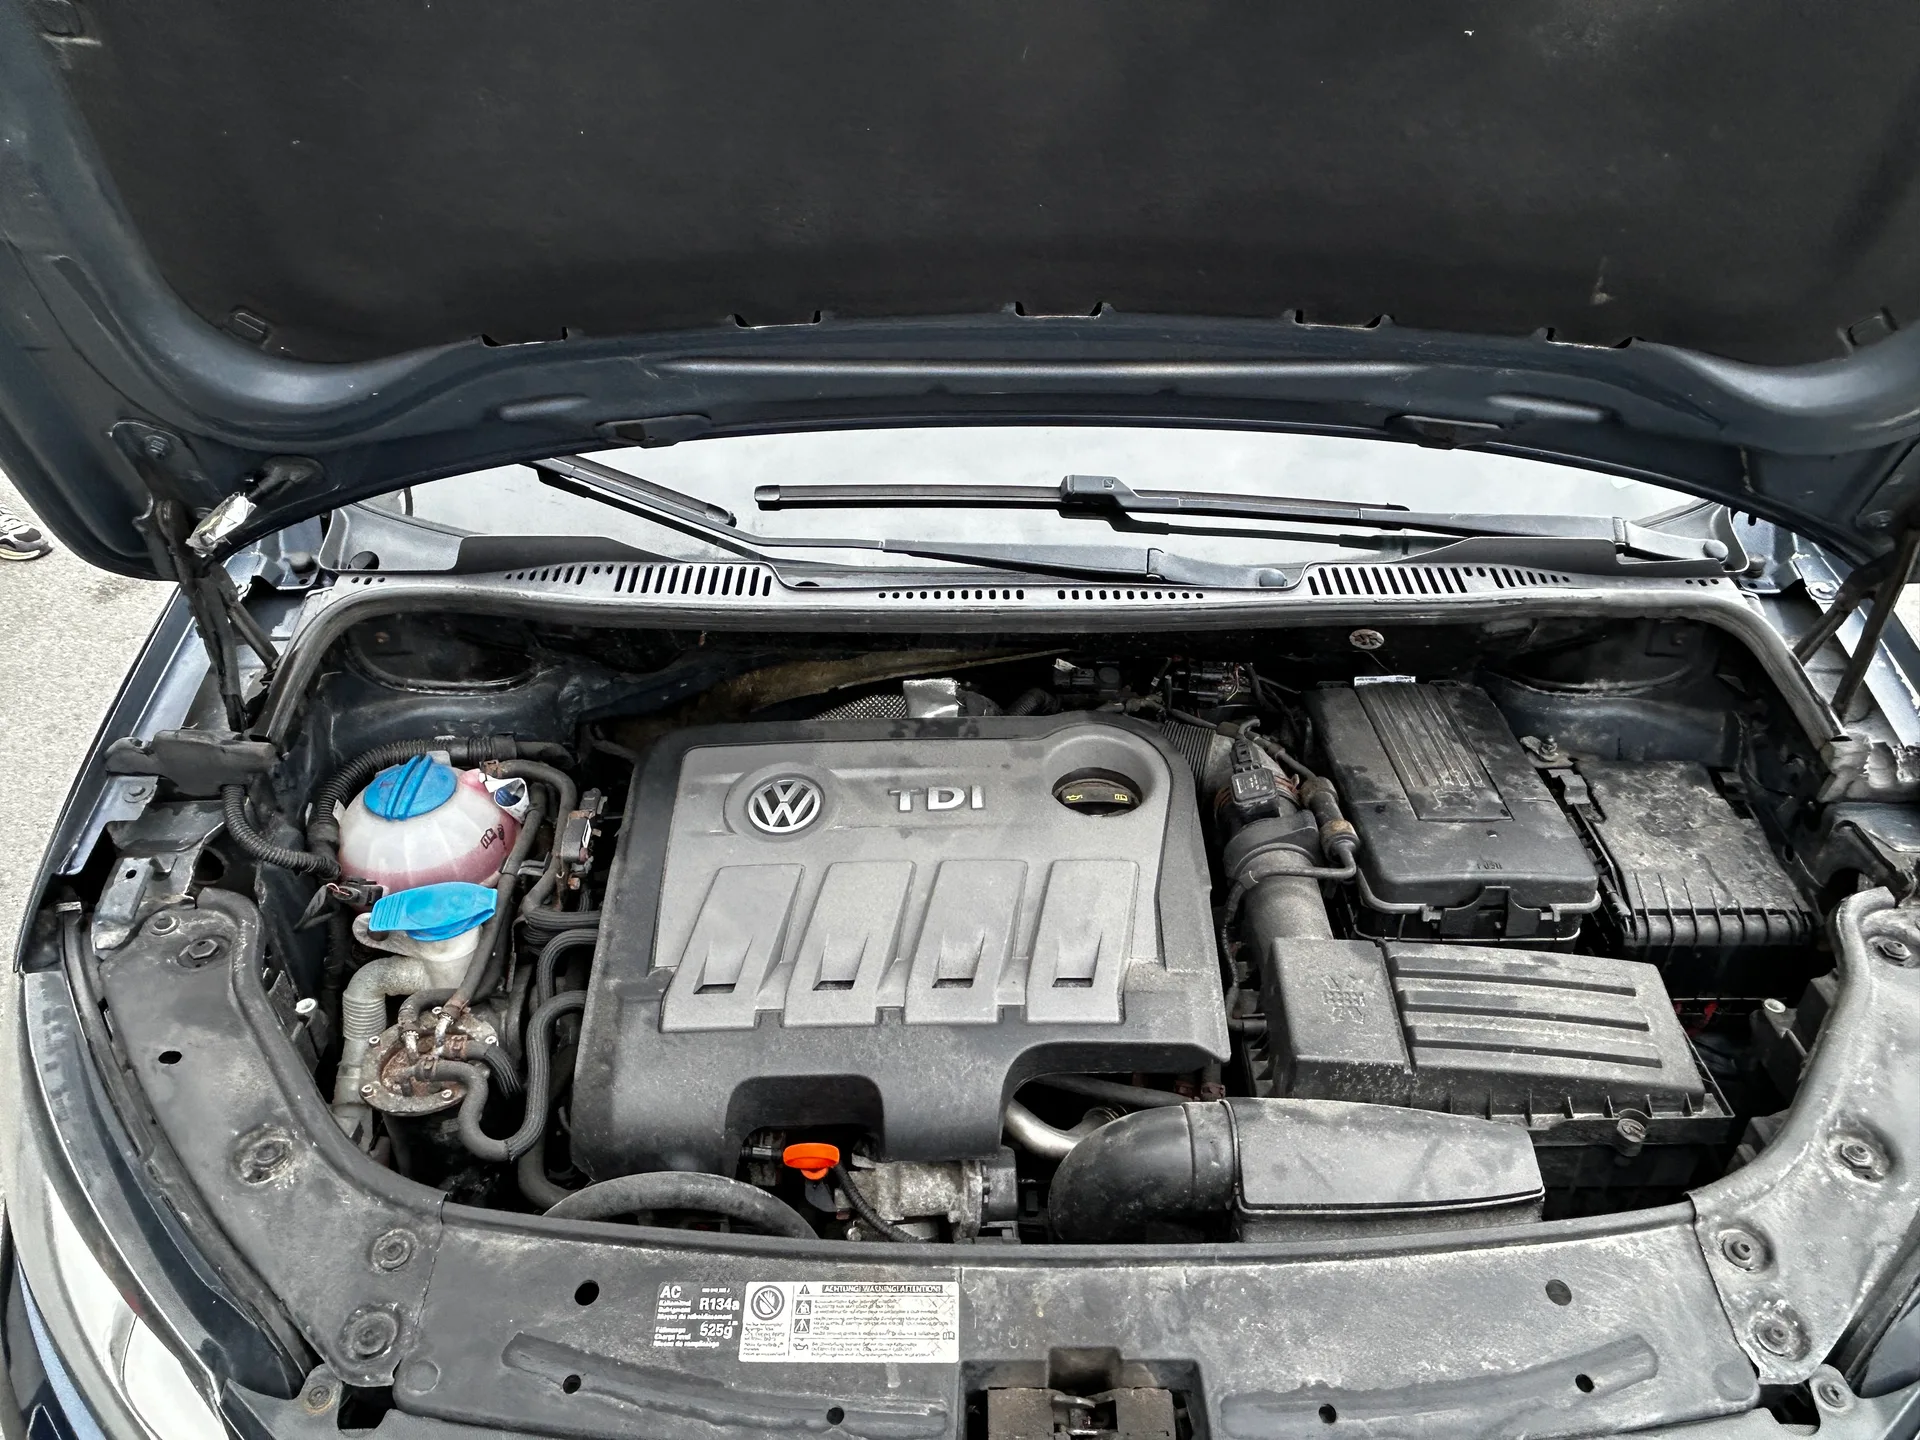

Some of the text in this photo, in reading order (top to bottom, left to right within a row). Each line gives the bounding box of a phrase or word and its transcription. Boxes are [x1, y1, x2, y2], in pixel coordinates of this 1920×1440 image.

[888, 785, 984, 811] TDI
[660, 1285, 682, 1298] AC
[700, 1297, 740, 1310] R134a
